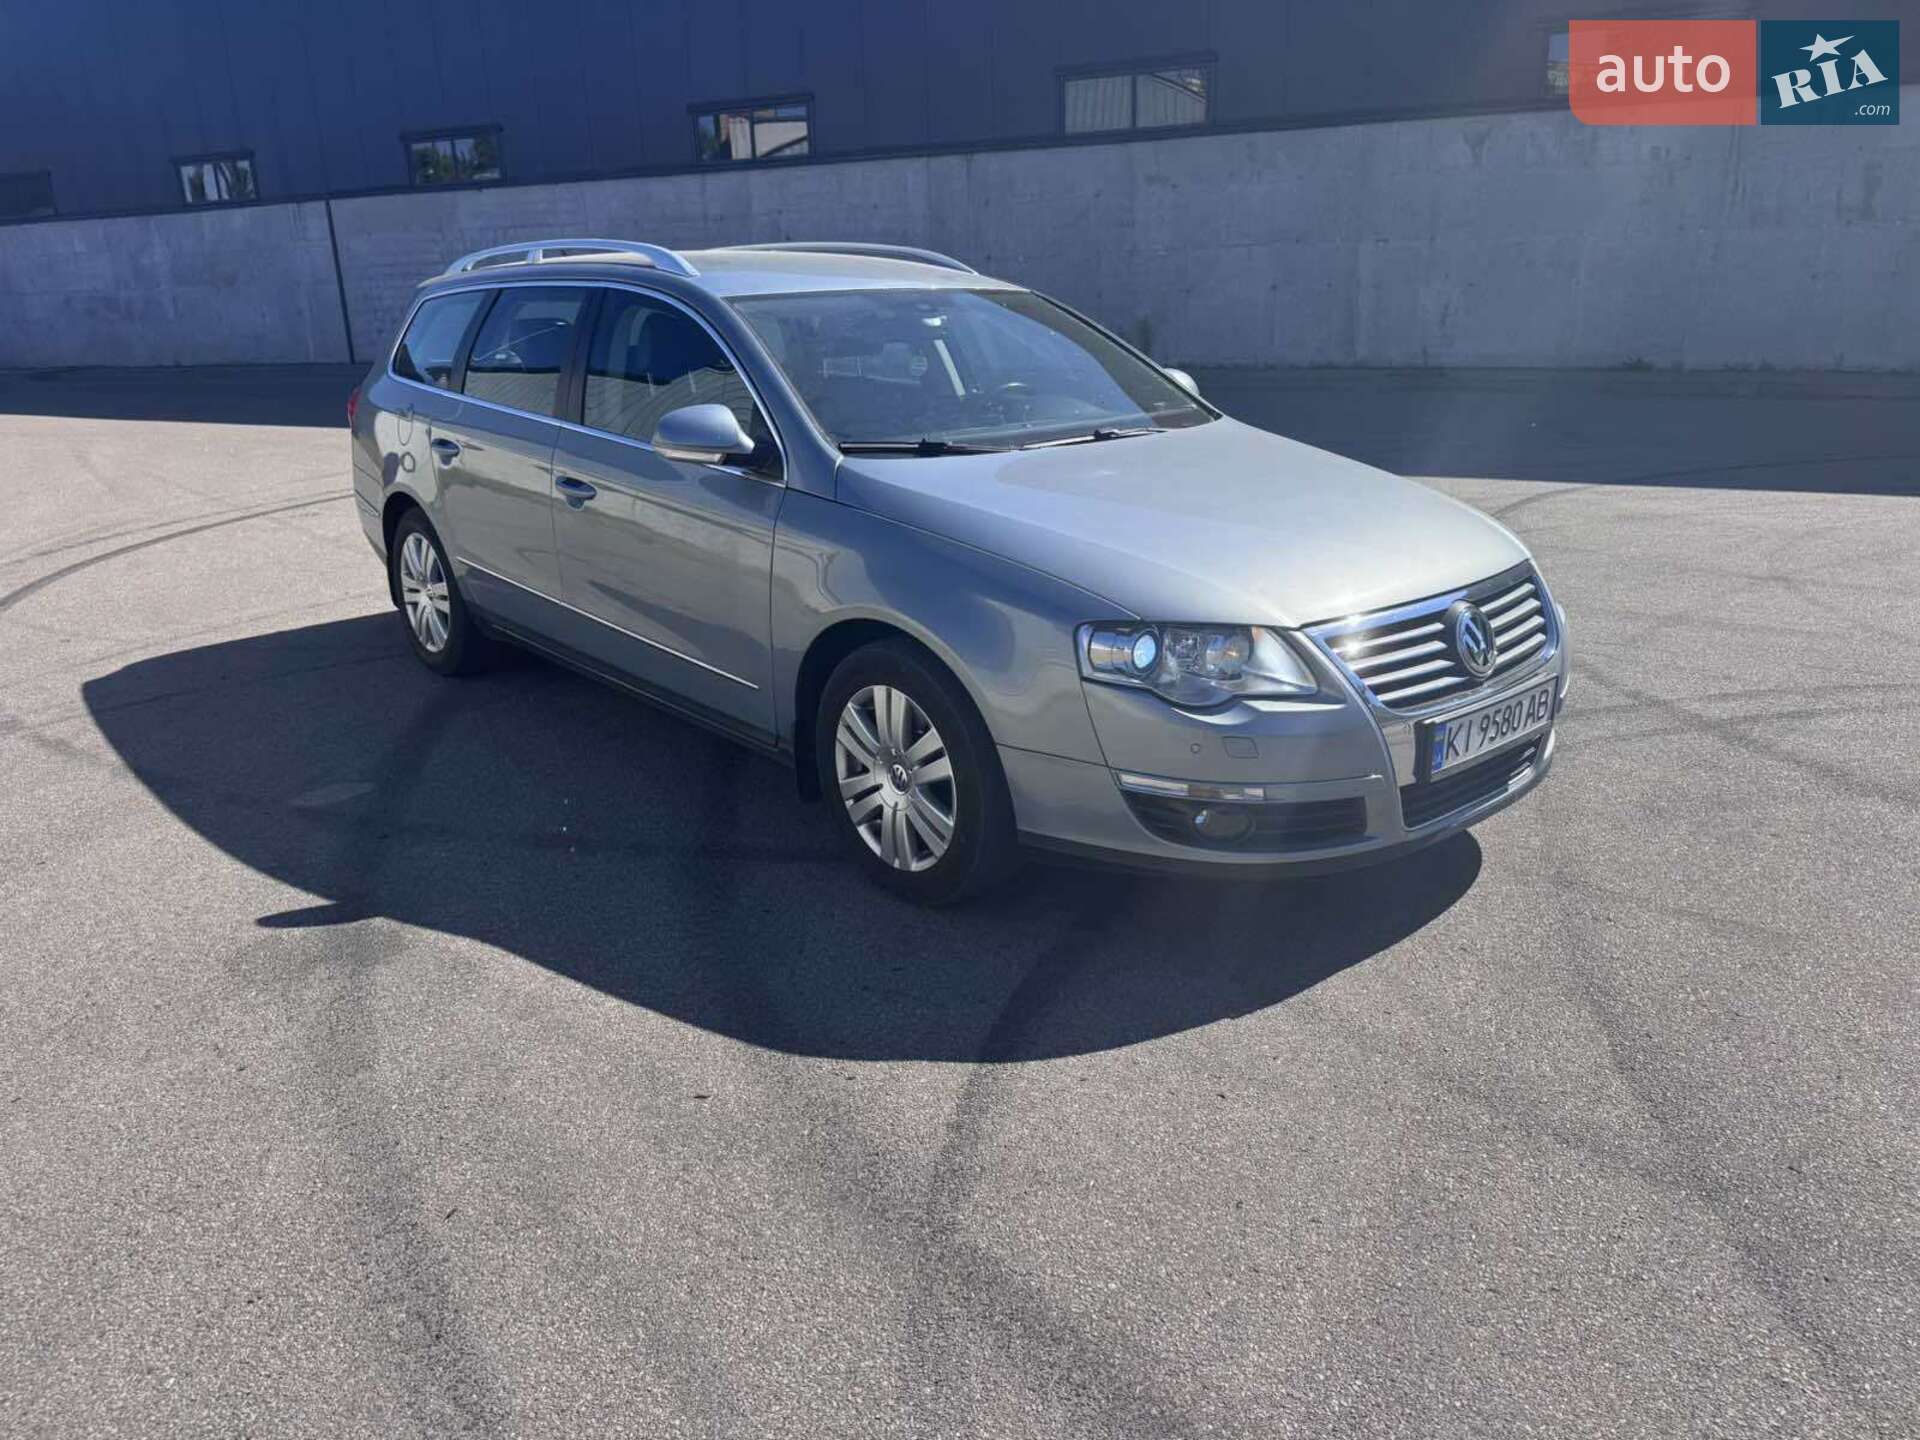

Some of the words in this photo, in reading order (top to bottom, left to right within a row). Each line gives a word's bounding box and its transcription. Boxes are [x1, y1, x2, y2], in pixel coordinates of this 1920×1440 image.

[1445, 719, 1472, 760] KI
[1479, 700, 1523, 748] 9580
[1523, 689, 1550, 728] AB
